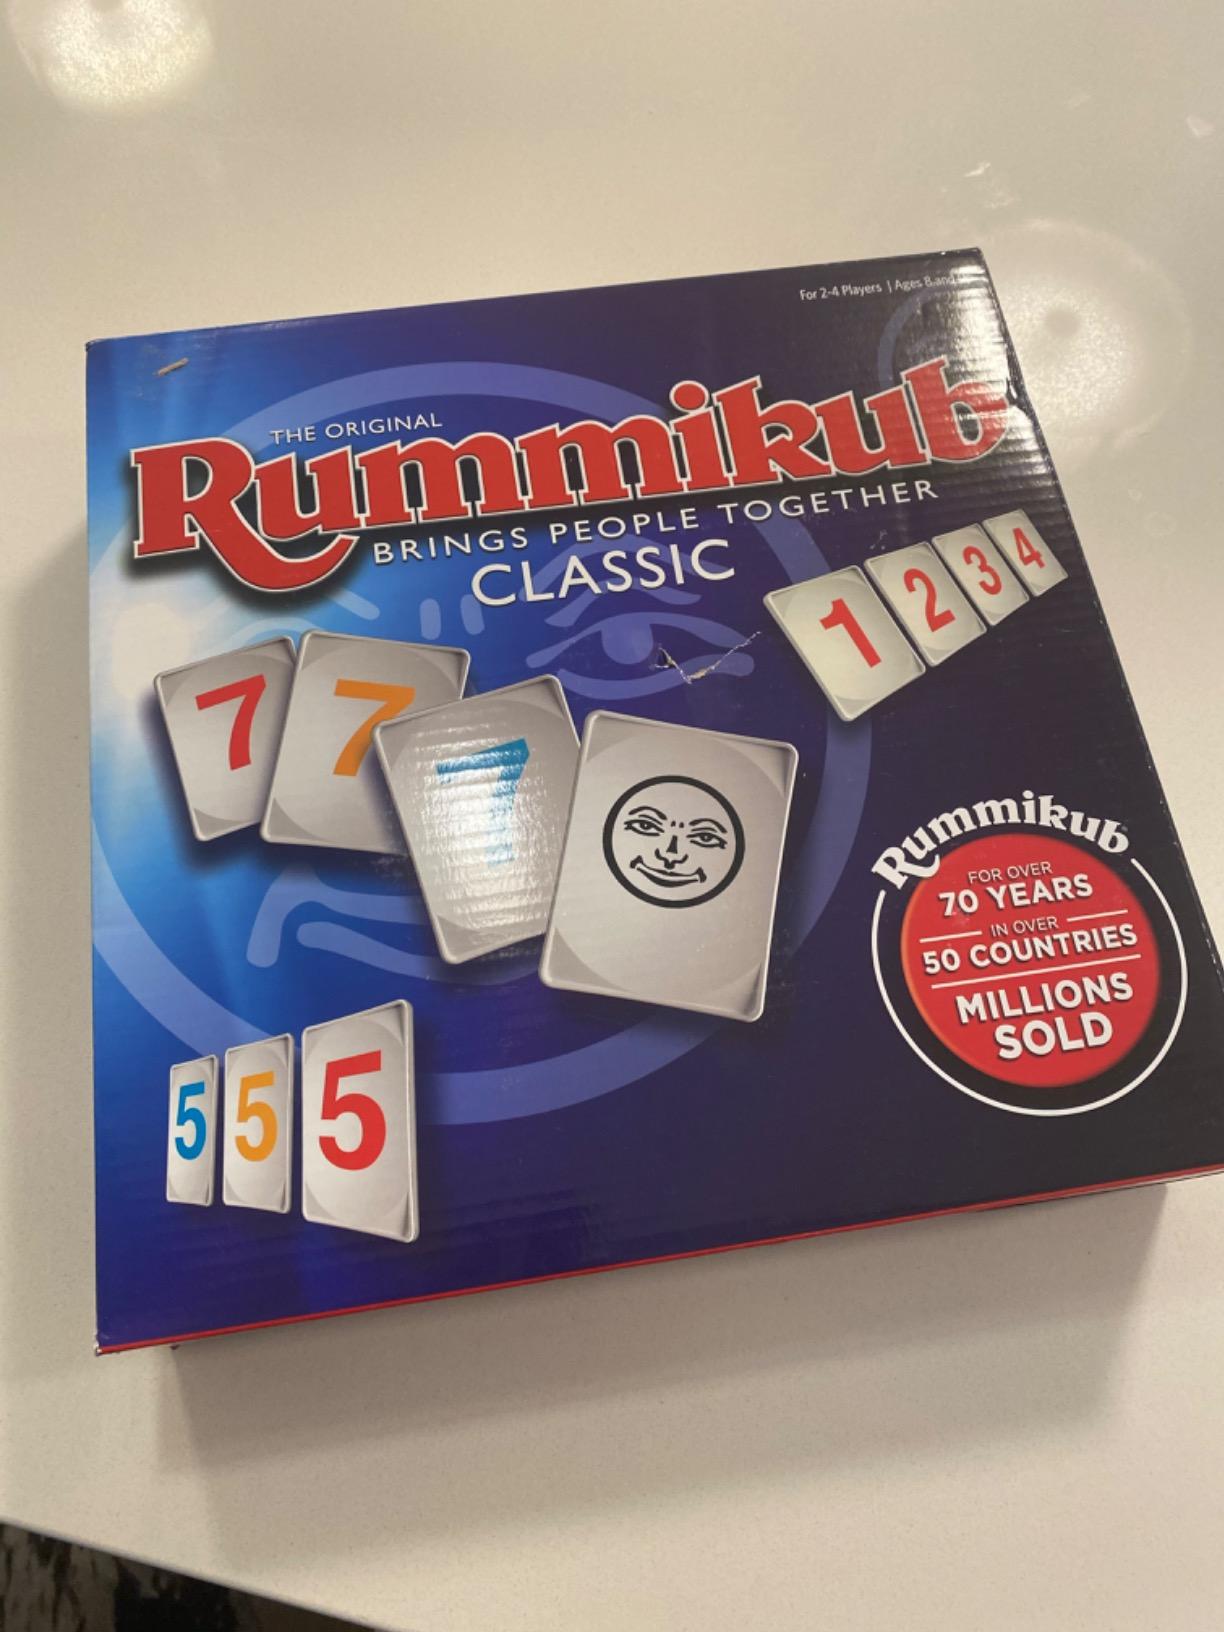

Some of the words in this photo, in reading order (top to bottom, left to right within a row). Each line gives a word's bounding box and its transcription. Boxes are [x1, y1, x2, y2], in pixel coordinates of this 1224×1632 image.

[800, 289, 818, 301] For
[820, 287, 840, 299] 2-4
[842, 283, 882, 298] Players
[894, 279, 922, 292] Ages
[270, 426, 317, 445] THE
[325, 413, 443, 439] ORIGINAL
[130, 355, 1010, 593] Rummikub
[373, 527, 529, 565] BRINGS
[550, 507, 700, 545] PEOPLE
[717, 479, 939, 525] TOGETHER
[471, 538, 736, 607] CLASSIC
[819, 597, 882, 668] 1
[903, 567, 957, 632] 2
[962, 545, 1003, 595] 3
[1012, 527, 1046, 569] 4
[195, 674, 267, 771] 7
[332, 678, 416, 777] 7
[435, 737, 531, 868] 7
[871, 790, 1130, 890] Rummikub
[938, 889, 979, 917] 70
[986, 873, 1094, 910] YEARS
[968, 868, 1003, 884] FOR
[1007, 861, 1053, 879] OVER
[922, 948, 961, 975] 50
[969, 924, 1138, 968] COUNTRIES
[990, 924, 1008, 937] IN
[1012, 916, 1059, 934] OVER
[955, 972, 1133, 1025] MILLIONS
[994, 1011, 1113, 1060] SOLD
[174, 1080, 207, 1161] 5
[234, 1071, 278, 1162] 5
[318, 1049, 387, 1171] 5
